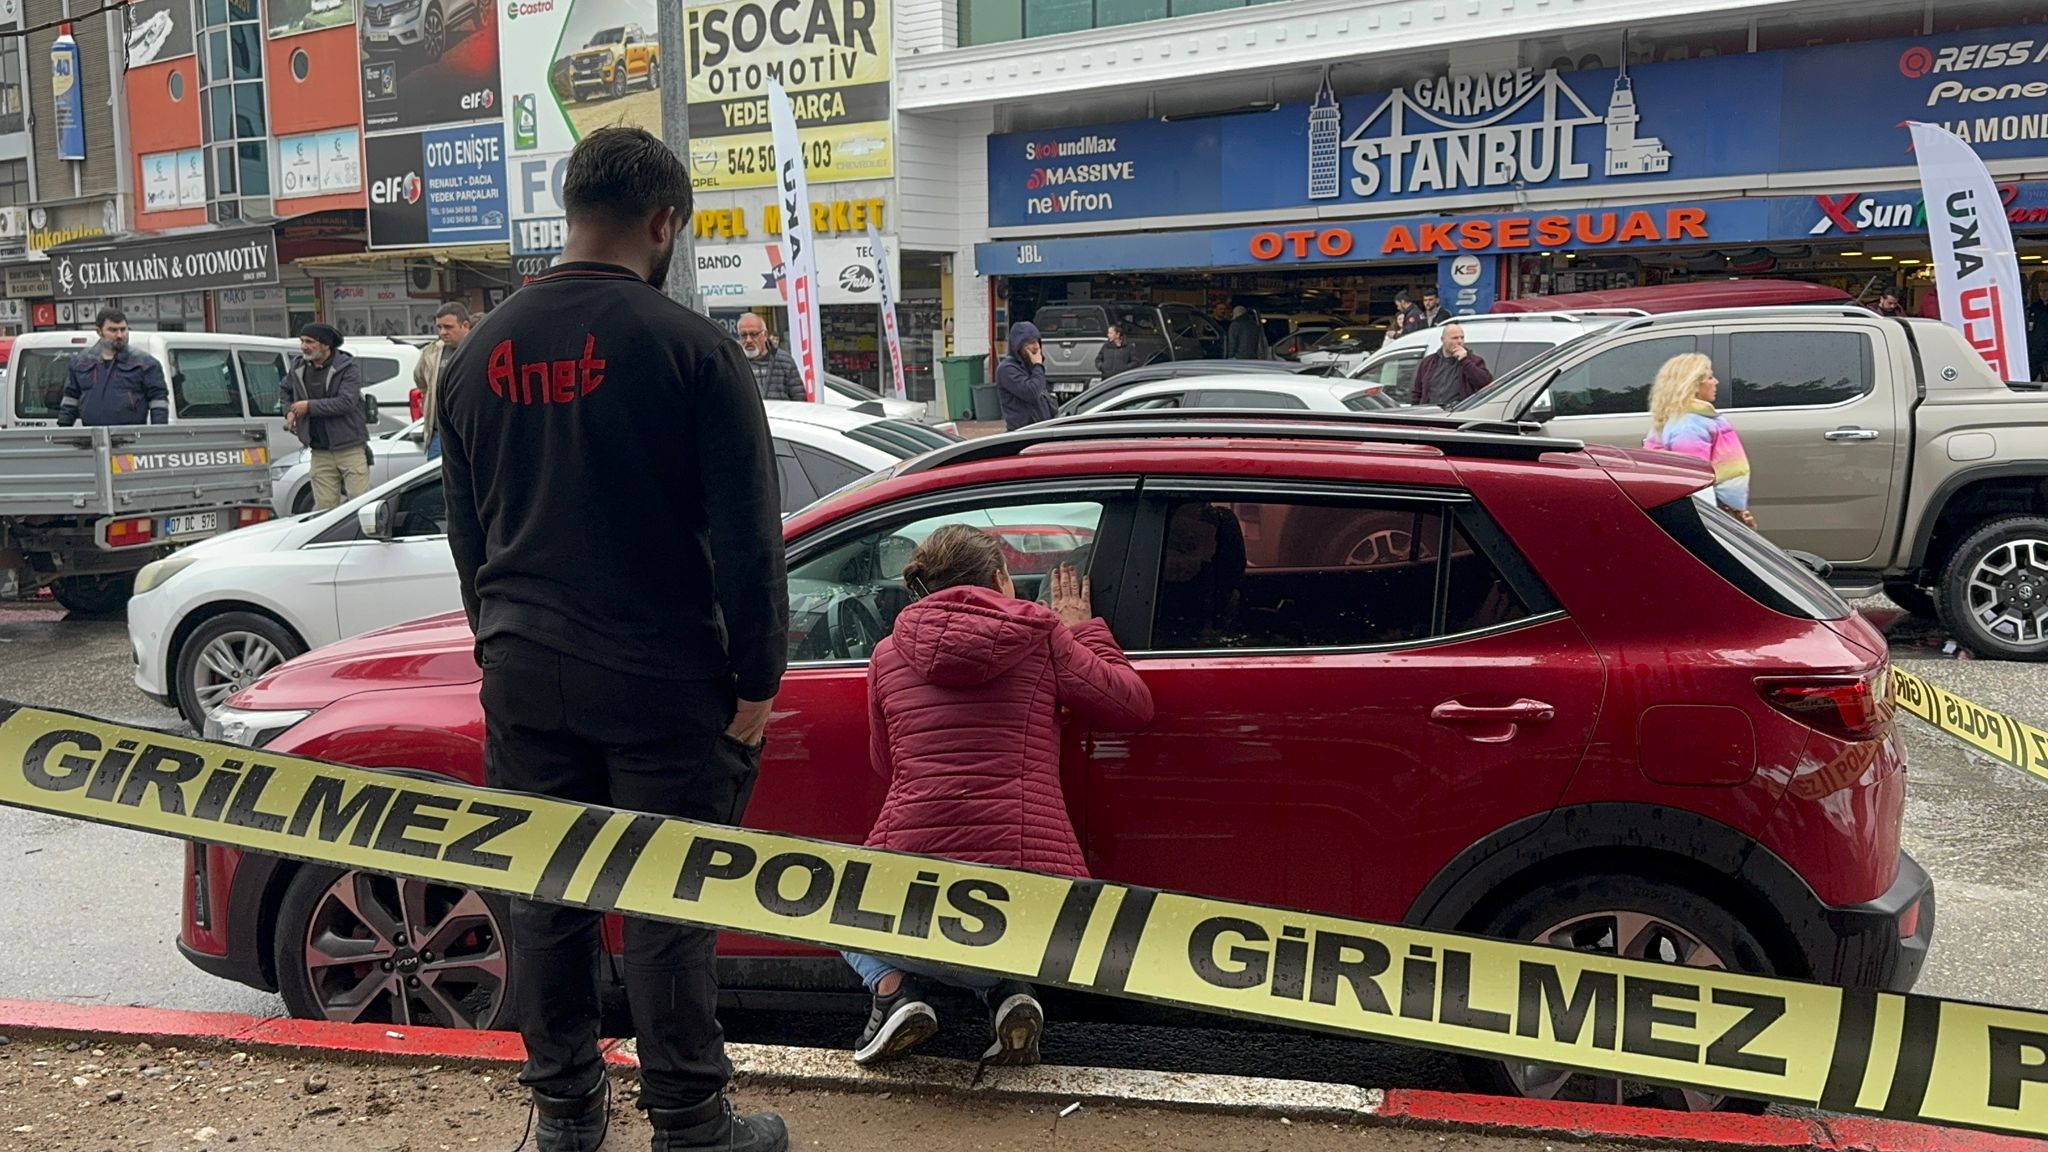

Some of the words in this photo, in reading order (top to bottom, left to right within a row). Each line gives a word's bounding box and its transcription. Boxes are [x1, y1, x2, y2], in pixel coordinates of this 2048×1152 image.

[1932, 40, 2034, 74] REISS
[461, 92, 481, 109] elf
[1414, 66, 1535, 116] GARAGE
[721, 101, 771, 128] YEDE
[426, 141, 453, 168] OTO
[455, 133, 499, 170] ENİŞTE
[728, 146, 755, 175] 542
[759, 145, 776, 173] 50
[813, 139, 832, 168] 03
[429, 176, 463, 189] RENAULT
[468, 174, 493, 186] DACIA
[1046, 161, 1135, 185] MASSIVE
[371, 176, 402, 204] elf
[430, 191, 455, 203] YEDEK
[456, 188, 499, 202] PARÇALARI
[763, 198, 885, 235] MRKET
[1249, 228, 1353, 260] OTO
[1380, 207, 1709, 254] AKSESUAR
[79, 257, 121, 289] ÇELİK
[122, 253, 169, 283] MARİN
[171, 254, 183, 279] &
[185, 241, 268, 278] OTOMOTİV
[697, 254, 742, 270] BANDO
[1017, 245, 1042, 264] JBL
[488, 332, 606, 405] Anet
[133, 450, 245, 469] MITSUBISHI
[170, 516, 181, 532] 07
[185, 515, 195, 530] DC
[201, 513, 216, 529] 978
